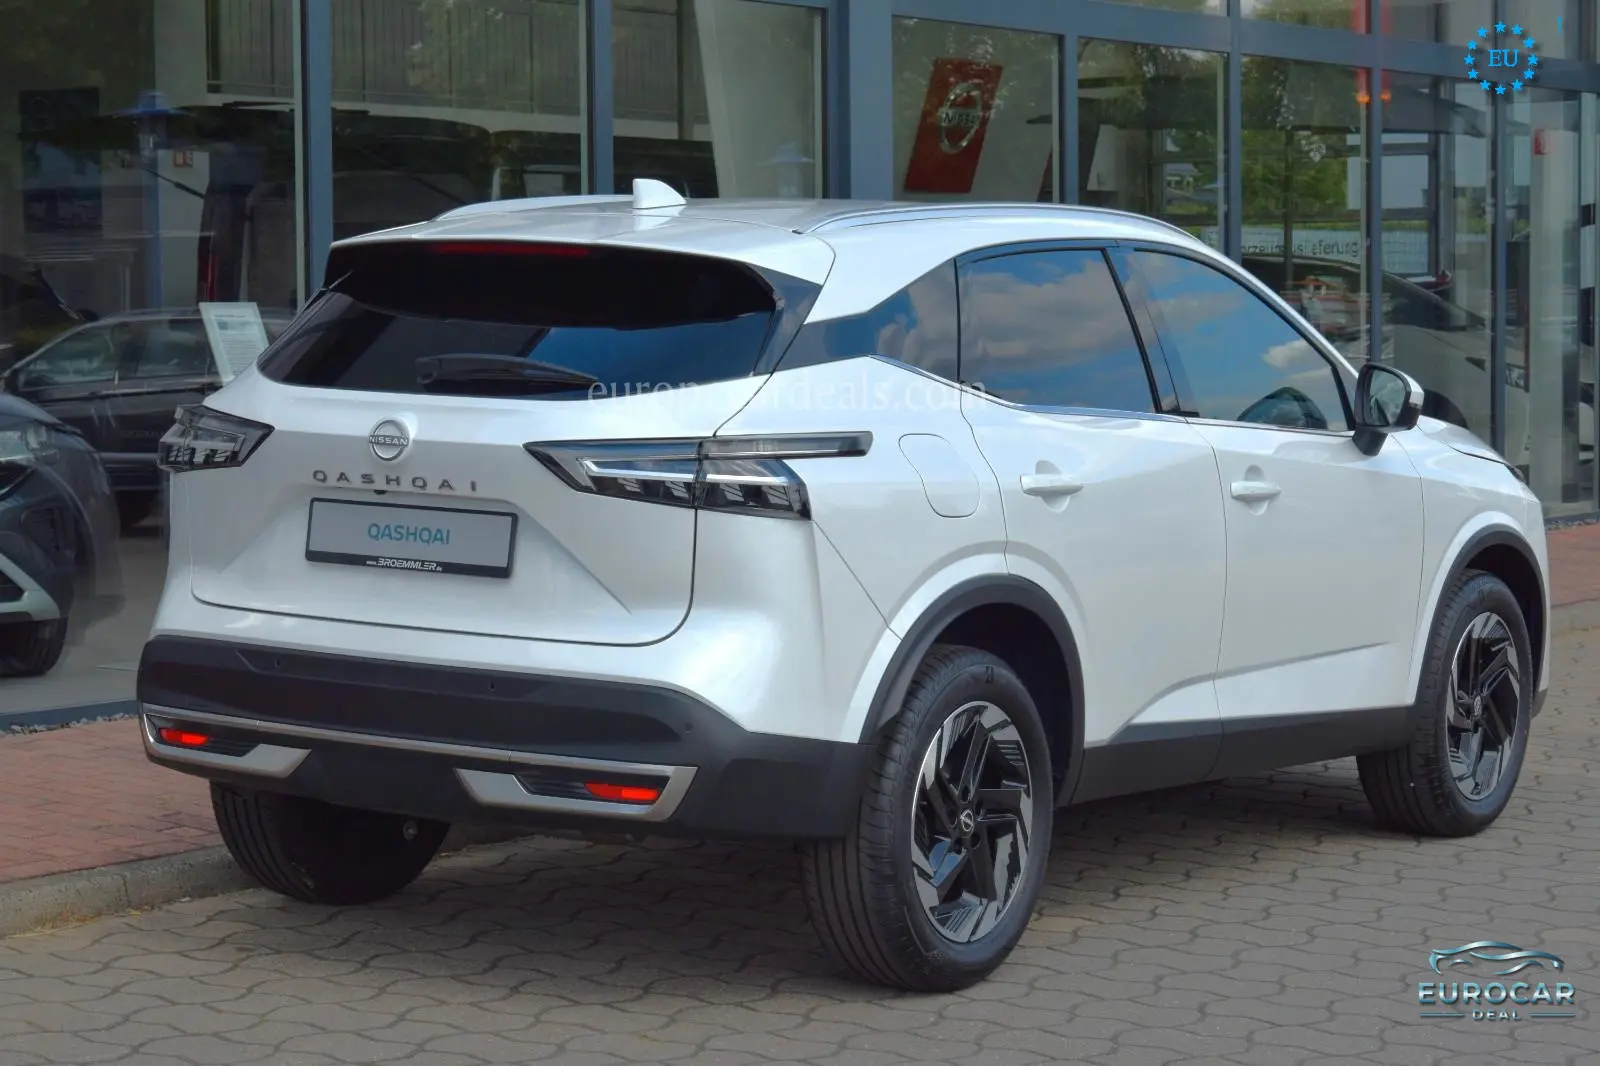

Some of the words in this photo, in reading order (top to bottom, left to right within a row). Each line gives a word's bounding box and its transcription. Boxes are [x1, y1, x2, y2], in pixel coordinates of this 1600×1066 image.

[369, 436, 408, 446] NISSAN
[312, 470, 477, 492] QASHQAI
[367, 523, 450, 545] QASHQAI
